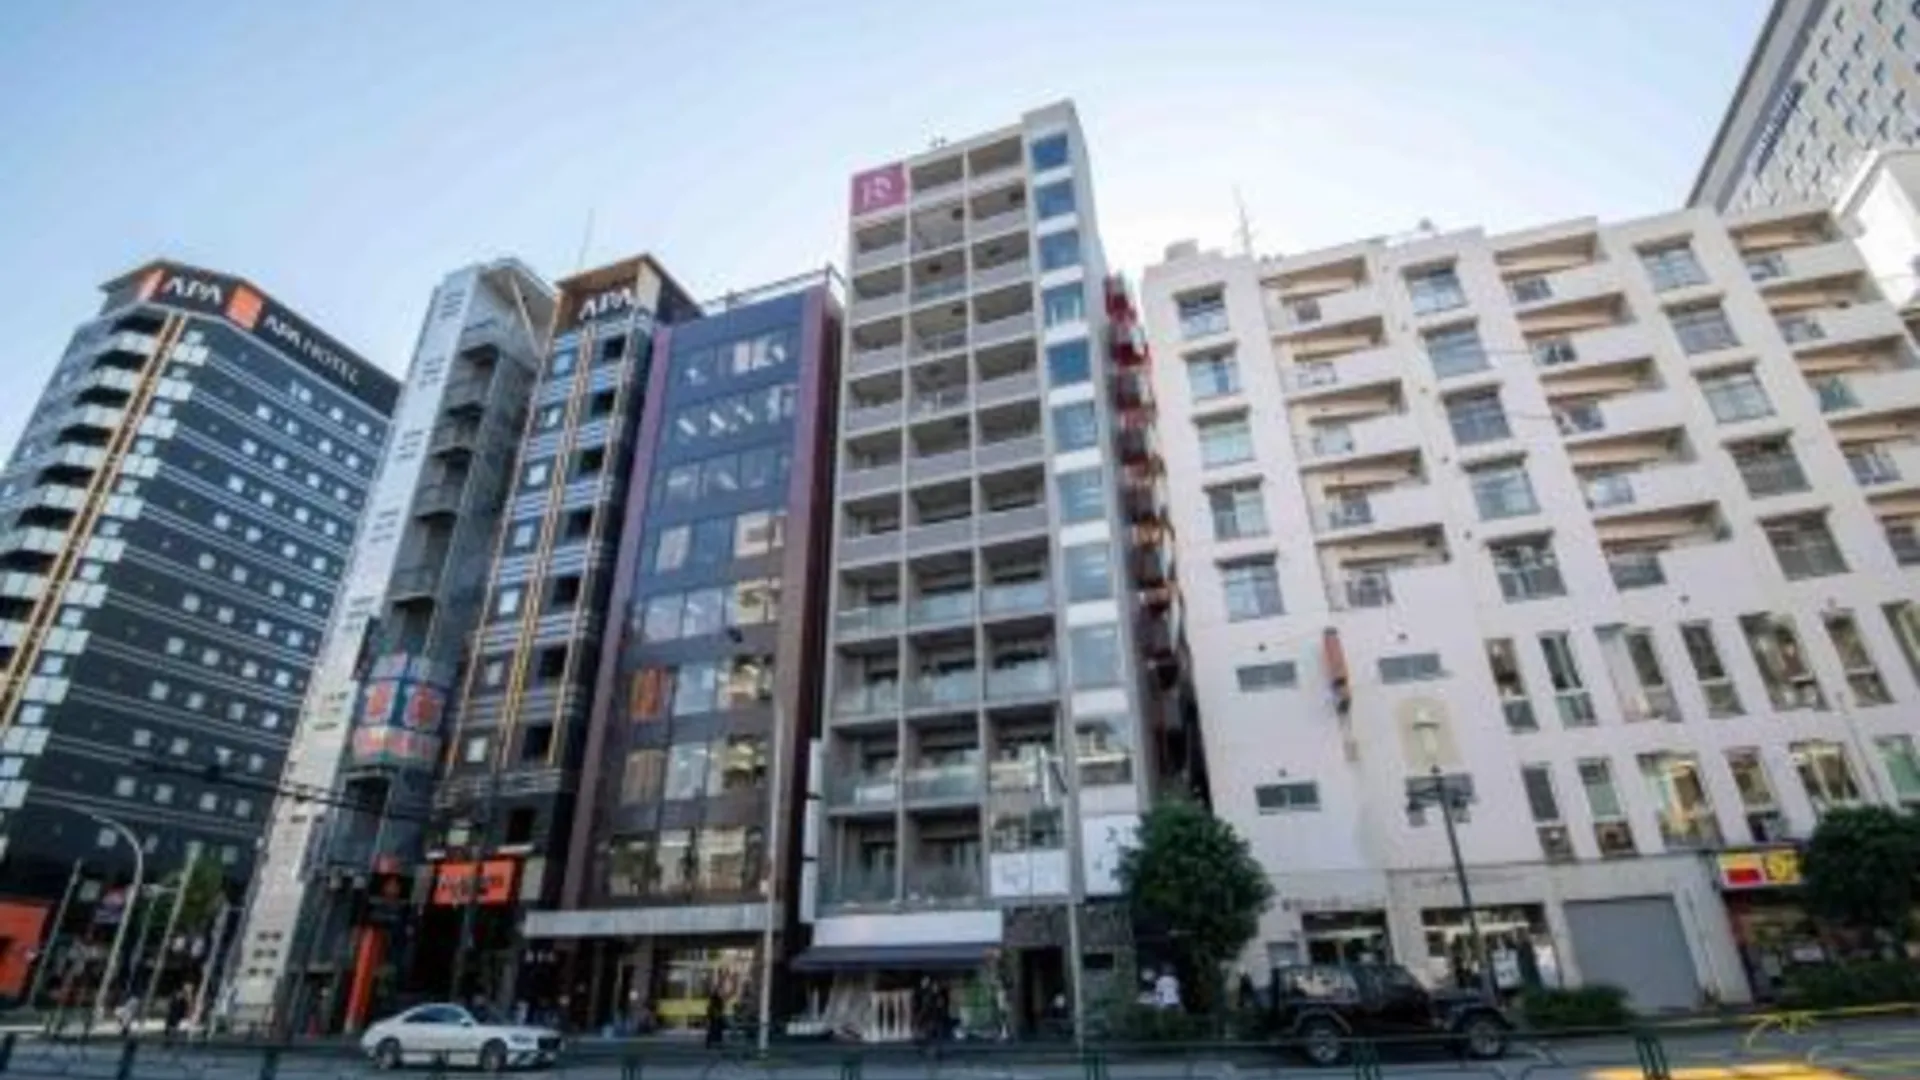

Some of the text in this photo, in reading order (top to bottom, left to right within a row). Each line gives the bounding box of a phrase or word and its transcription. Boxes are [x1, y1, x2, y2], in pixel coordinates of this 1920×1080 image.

[162, 275, 223, 305] APA
[577, 286, 635, 320] APA
[264, 314, 358, 385] APA HOTEL
